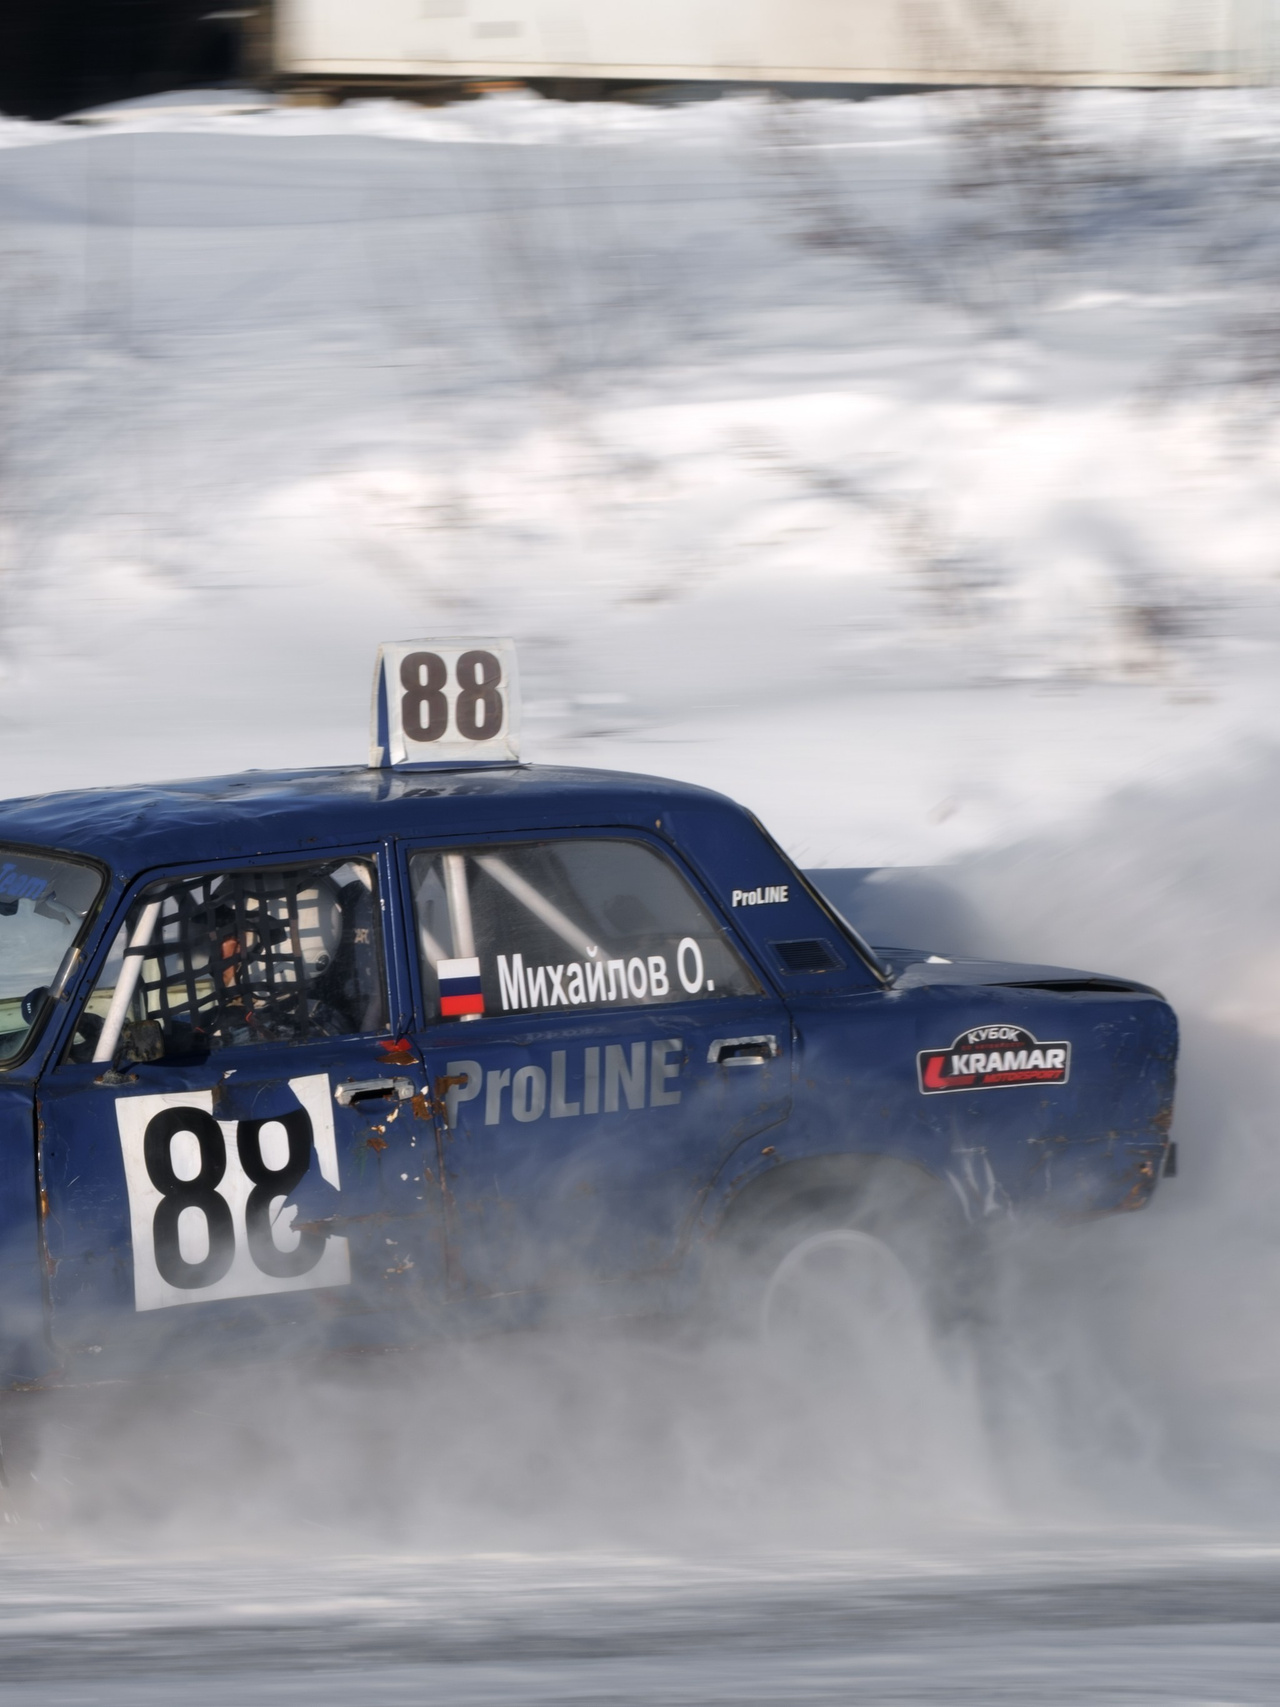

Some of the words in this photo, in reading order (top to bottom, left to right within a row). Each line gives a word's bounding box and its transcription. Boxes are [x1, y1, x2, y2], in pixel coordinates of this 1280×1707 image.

[400, 650, 503, 742] 88
[732, 885, 789, 907] ProLINE
[497, 946, 669, 1010] Михайлов
[677, 937, 715, 994] О.
[968, 1028, 1020, 1044] КУБОК
[446, 1038, 683, 1129] ProLINE
[951, 1049, 1066, 1075] KRAMAR
[982, 1069, 1064, 1083] MOTORSPORT
[144, 1106, 327, 1290] 88
